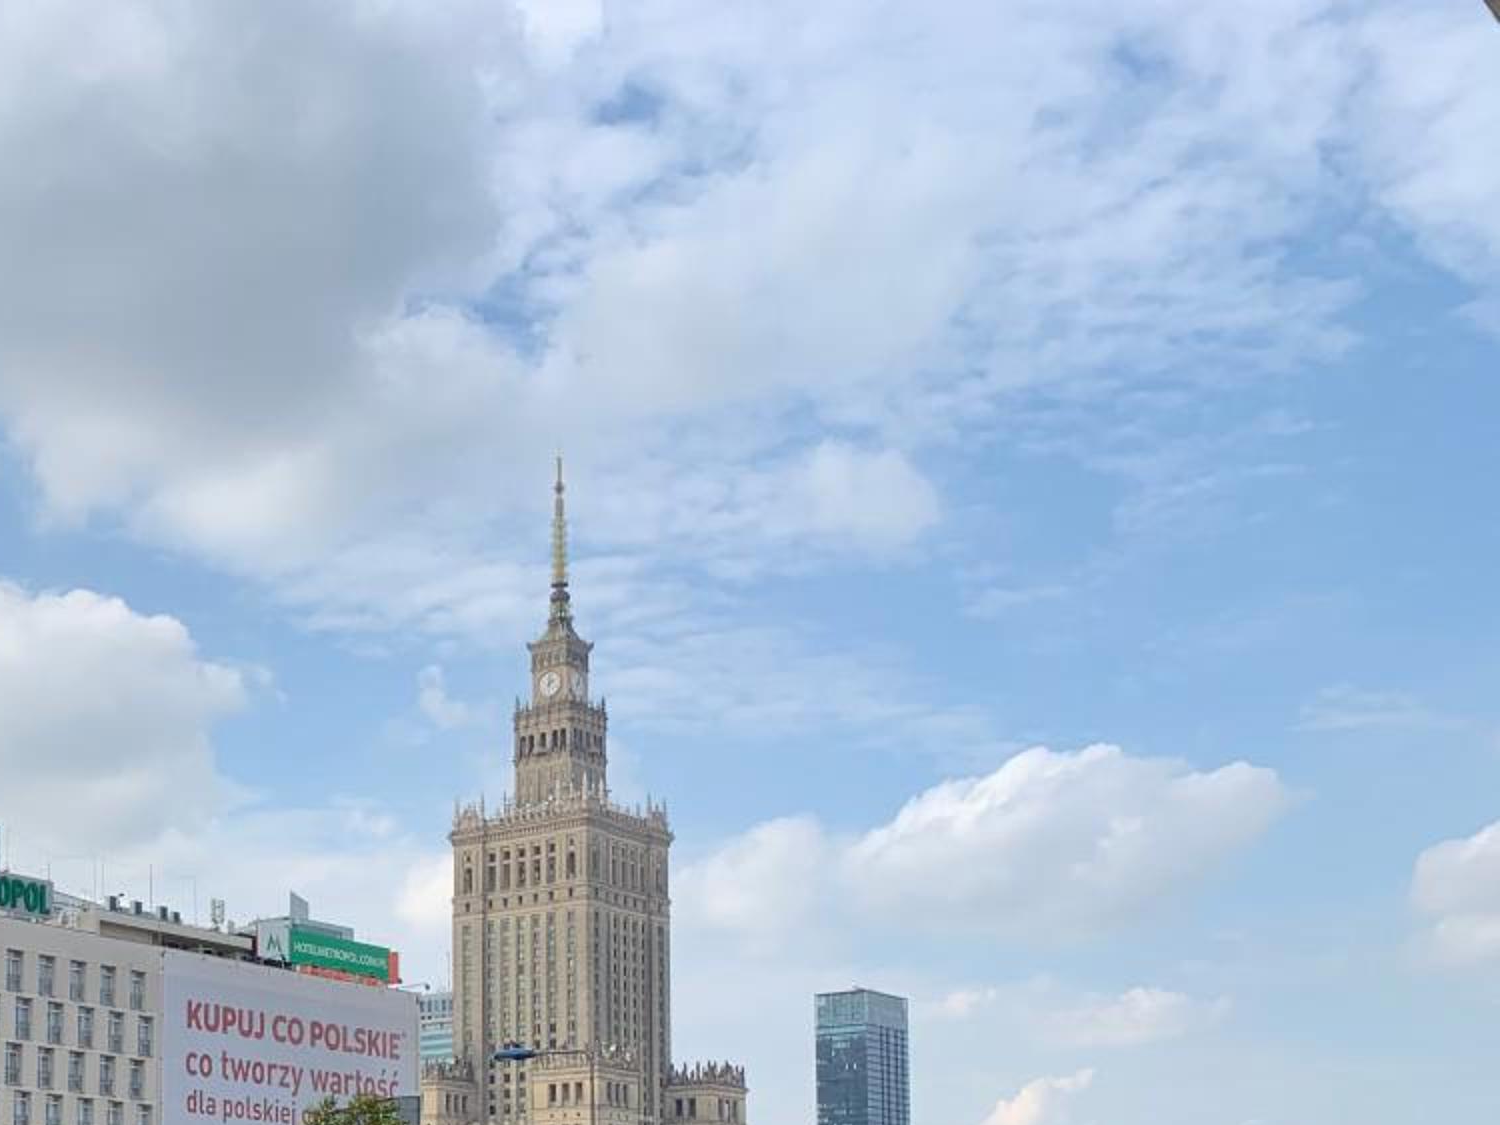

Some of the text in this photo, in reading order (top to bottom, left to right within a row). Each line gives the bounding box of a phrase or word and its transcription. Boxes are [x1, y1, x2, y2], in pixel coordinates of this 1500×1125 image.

[187, 1000, 265, 1040] KUPUJ
[272, 1015, 304, 1045] CO
[185, 1051, 213, 1078] co
[221, 1051, 304, 1097] tworzy
[187, 1090, 216, 1116] dla
